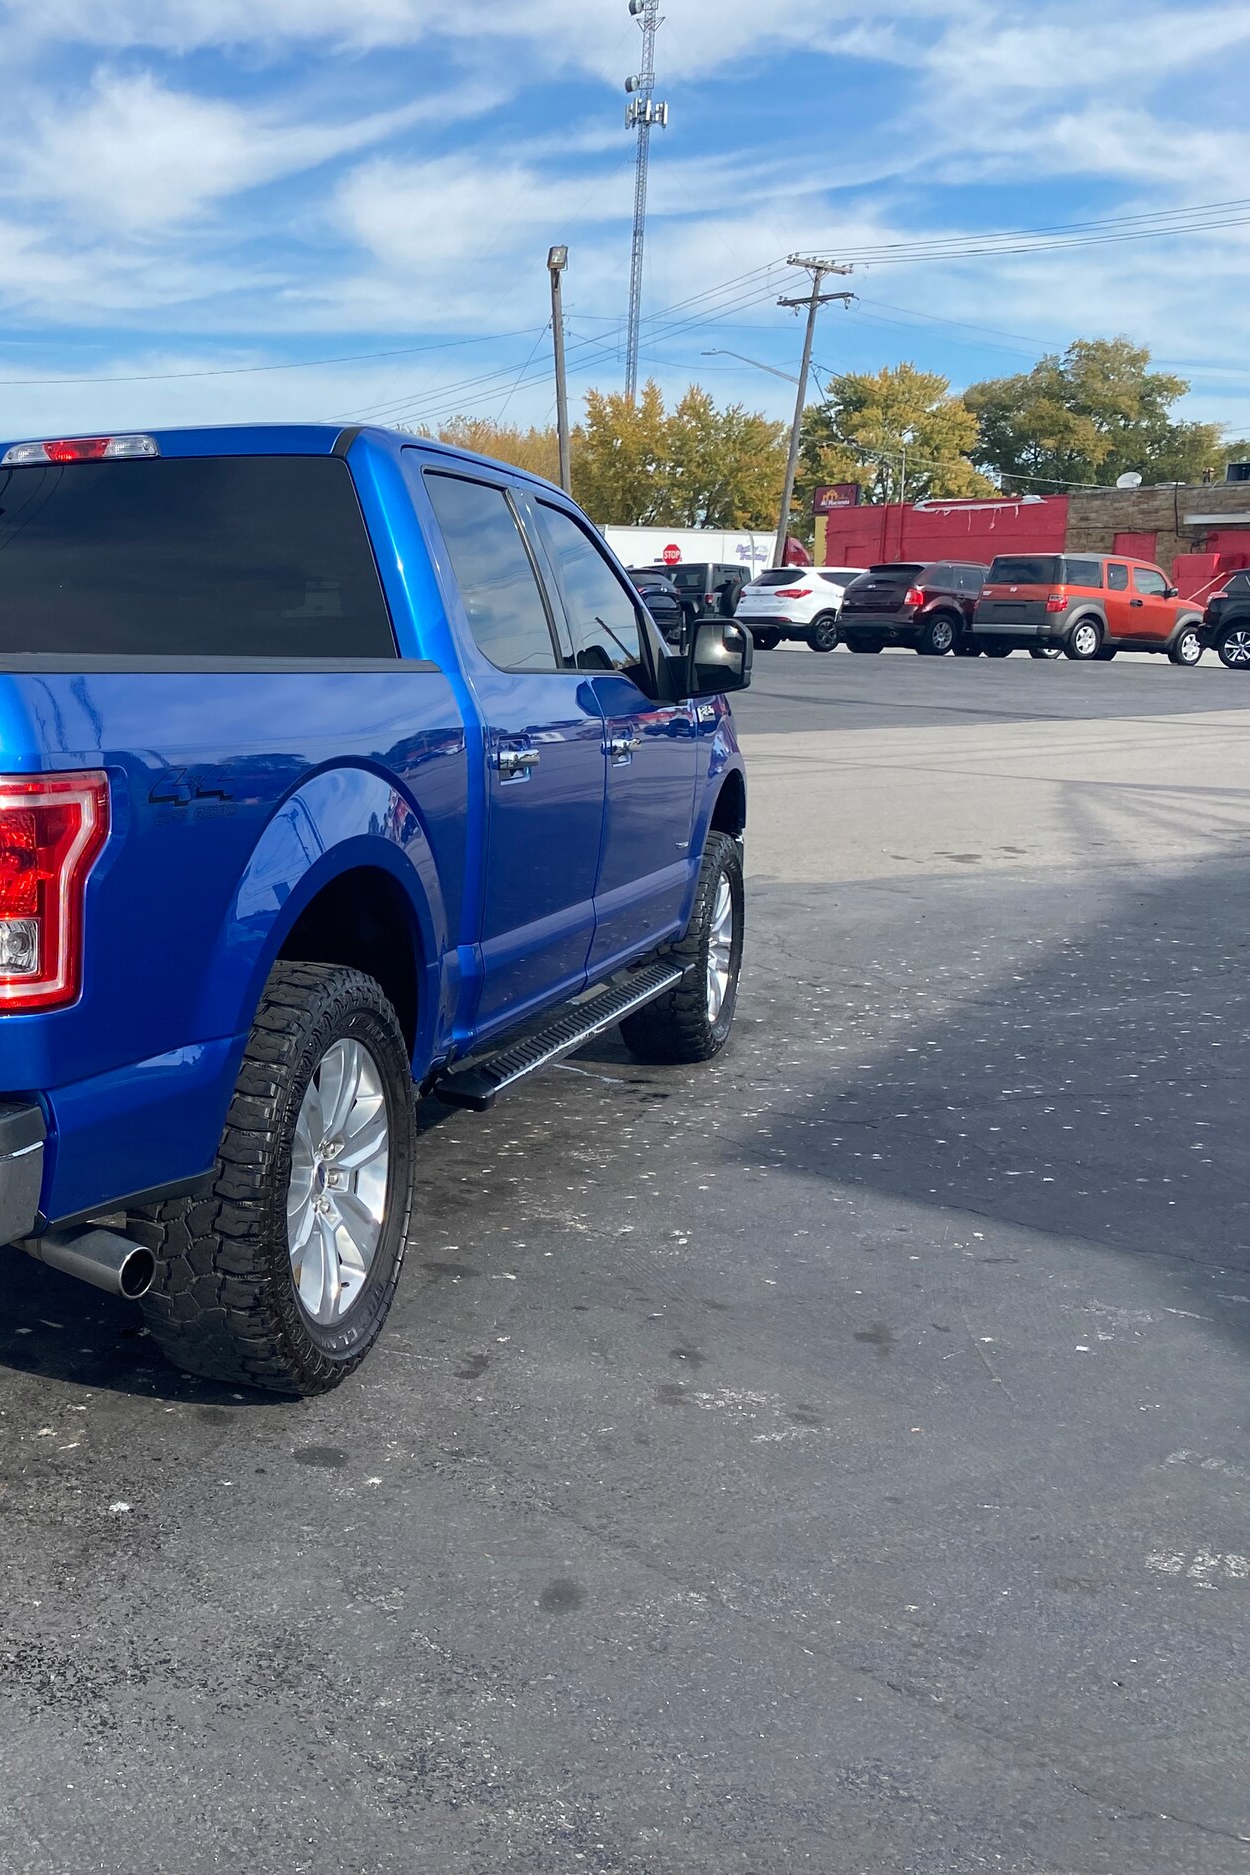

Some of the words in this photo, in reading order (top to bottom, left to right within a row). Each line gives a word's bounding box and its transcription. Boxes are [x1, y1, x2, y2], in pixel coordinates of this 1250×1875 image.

[664, 550, 680, 559] STOP
[154, 809, 190, 826] OFF
[194, 803, 239, 819] ROAD
